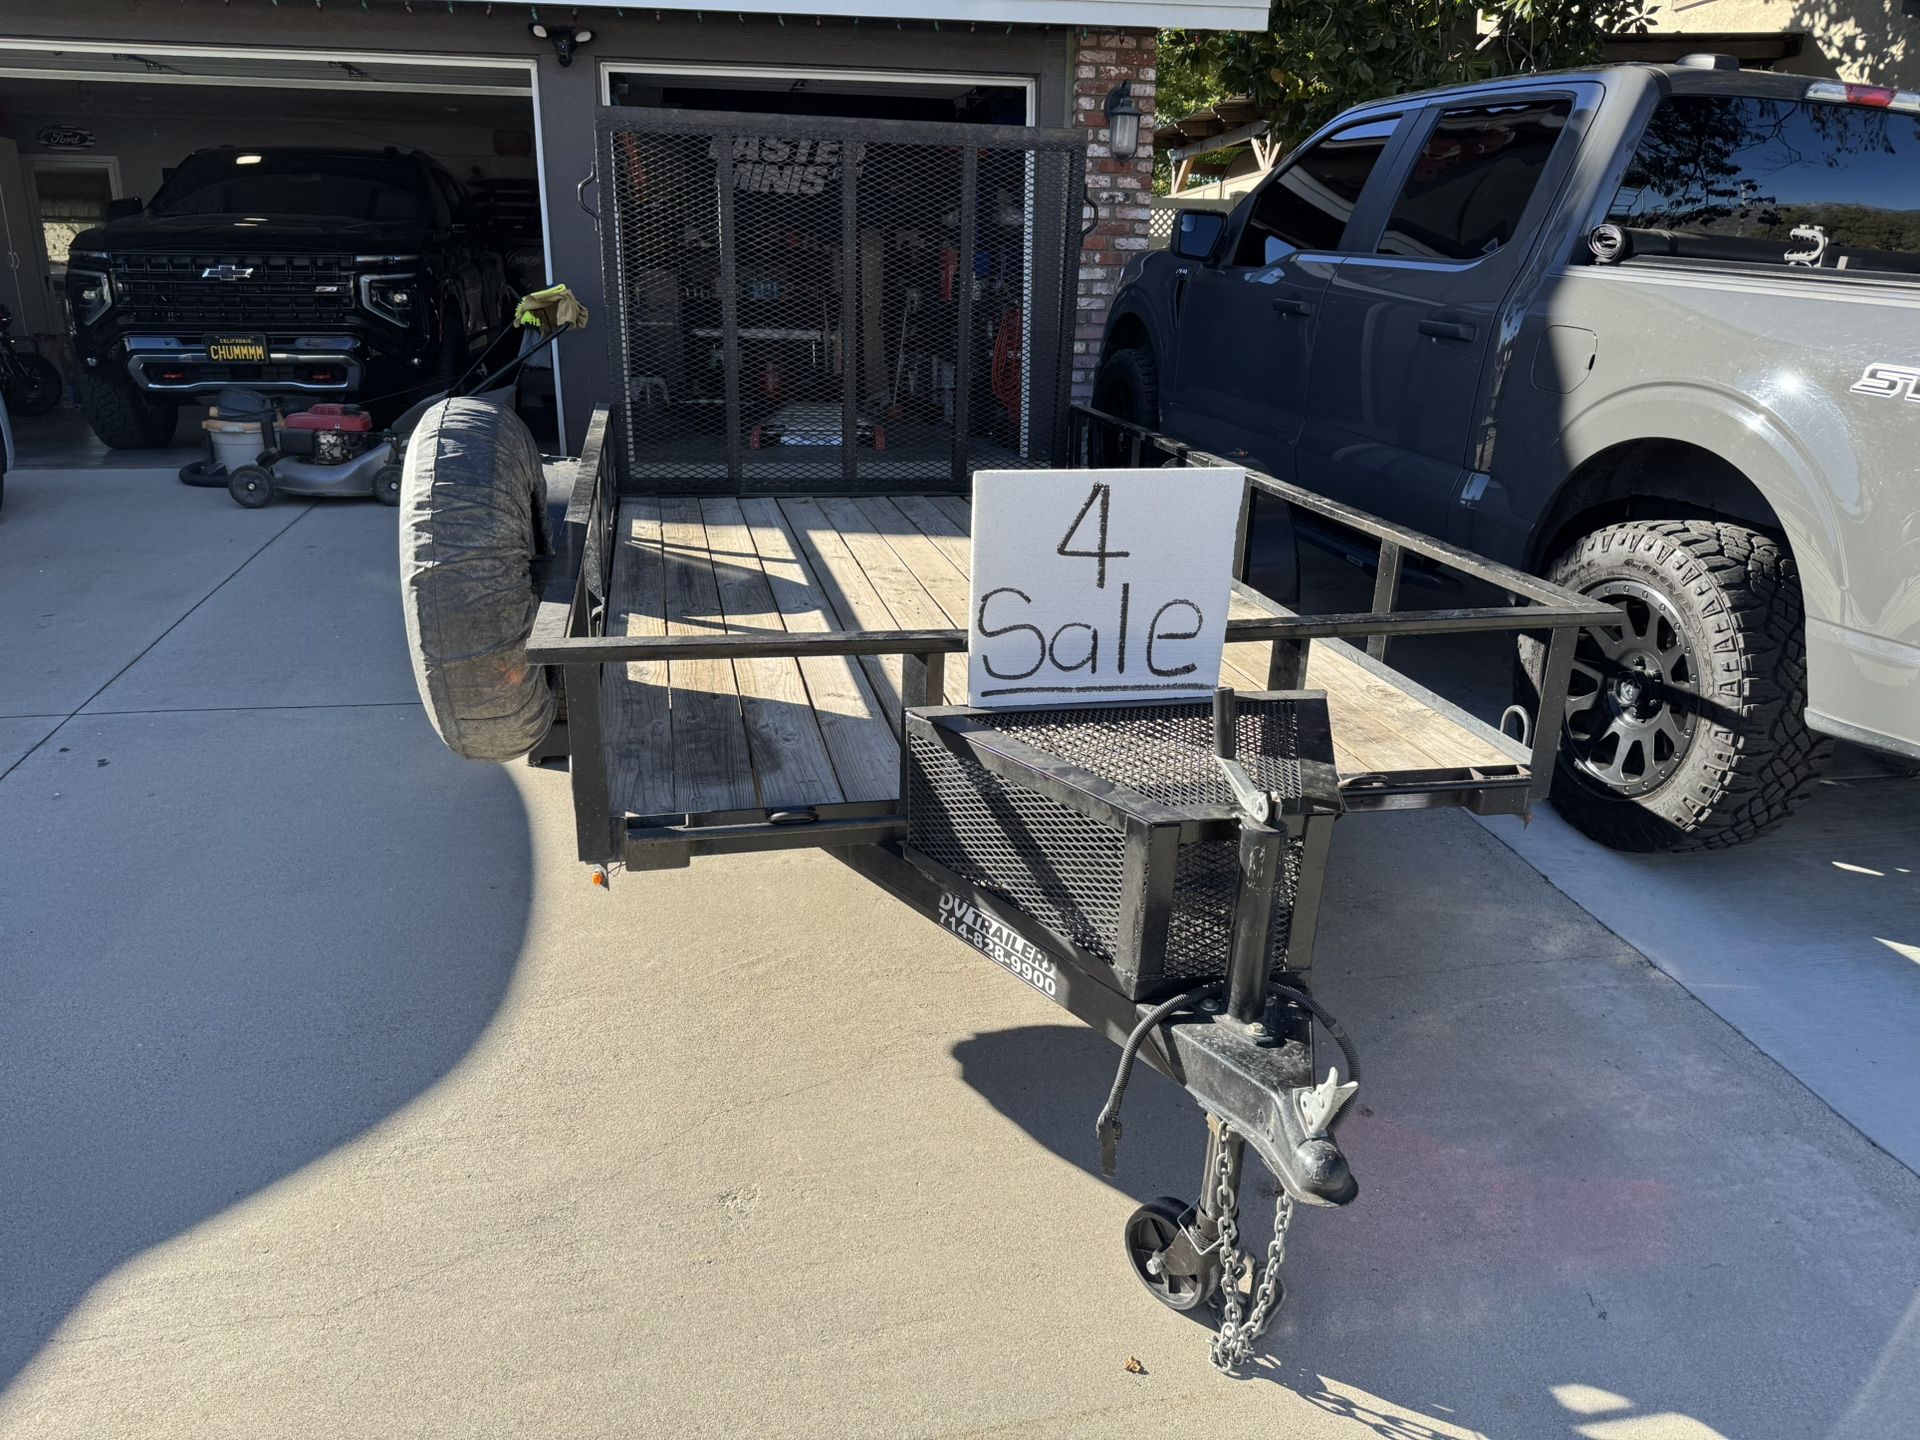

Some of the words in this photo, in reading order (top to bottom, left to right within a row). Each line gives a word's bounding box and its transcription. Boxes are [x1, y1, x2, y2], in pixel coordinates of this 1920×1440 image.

[50, 131, 80, 144] Ford
[210, 345, 265, 360] CHUMMMM
[1057, 481, 1130, 589] 4
[977, 583, 1203, 680] Sale
[938, 908, 1056, 996] 714-828-9900
